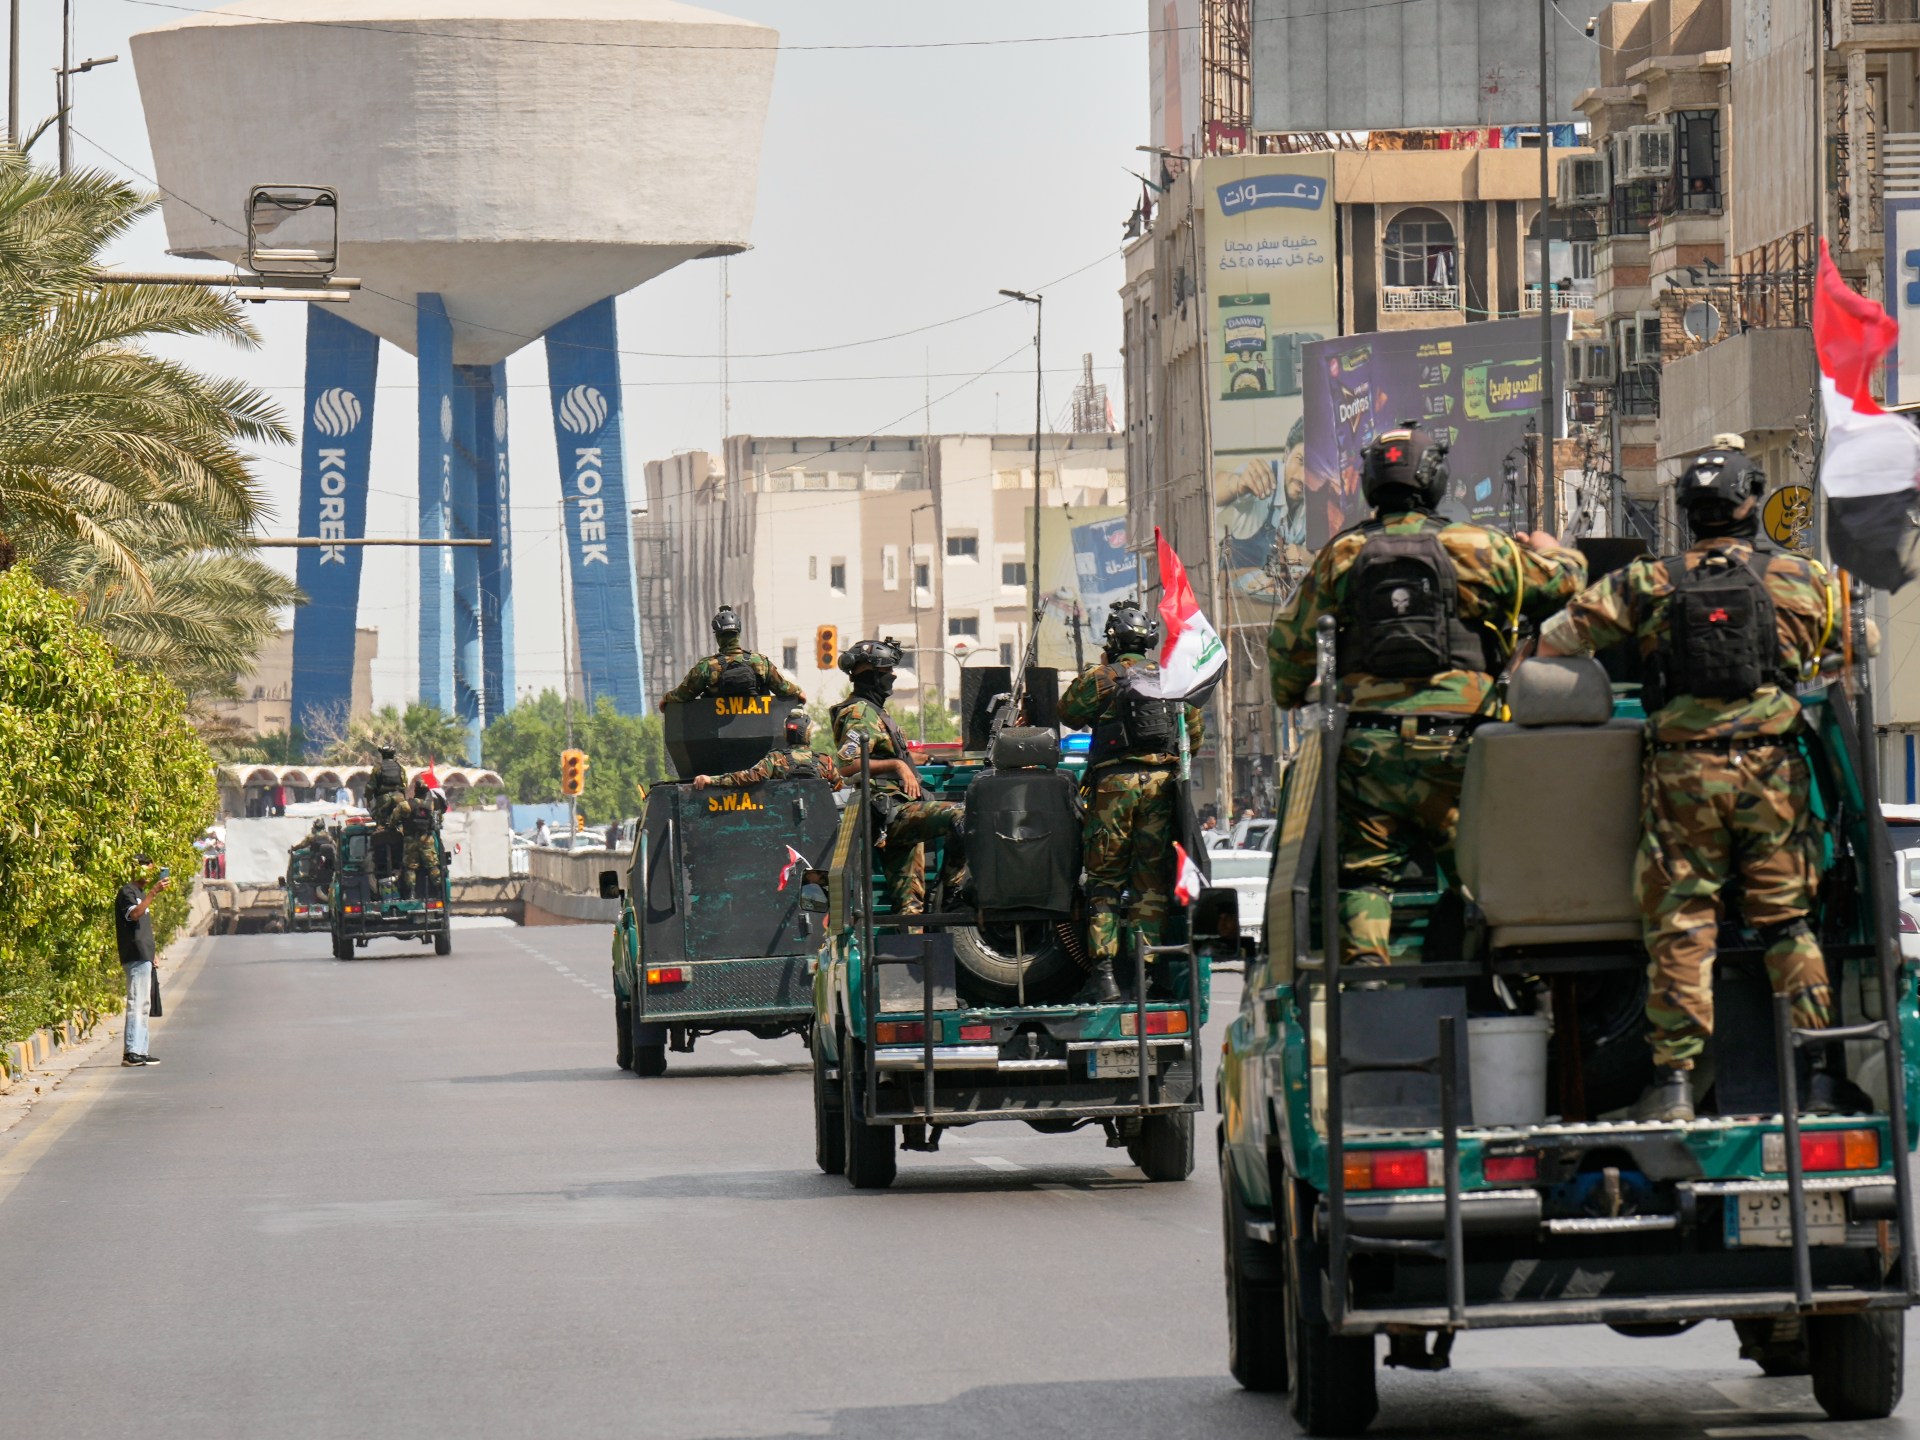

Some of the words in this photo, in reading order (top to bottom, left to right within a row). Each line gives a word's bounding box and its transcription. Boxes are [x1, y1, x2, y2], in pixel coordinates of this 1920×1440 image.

[1224, 182, 1320, 206] دعوات
[1256, 238, 1280, 252] سفر
[1282, 235, 1318, 250] حقيبة
[1257, 254, 1283, 268] عبوة
[1285, 253, 1304, 267] كل
[1339, 396, 1369, 423] Doritos
[319, 448, 346, 566] KOREK
[575, 447, 609, 567] KOREK
[715, 696, 772, 716] S.W.A.T
